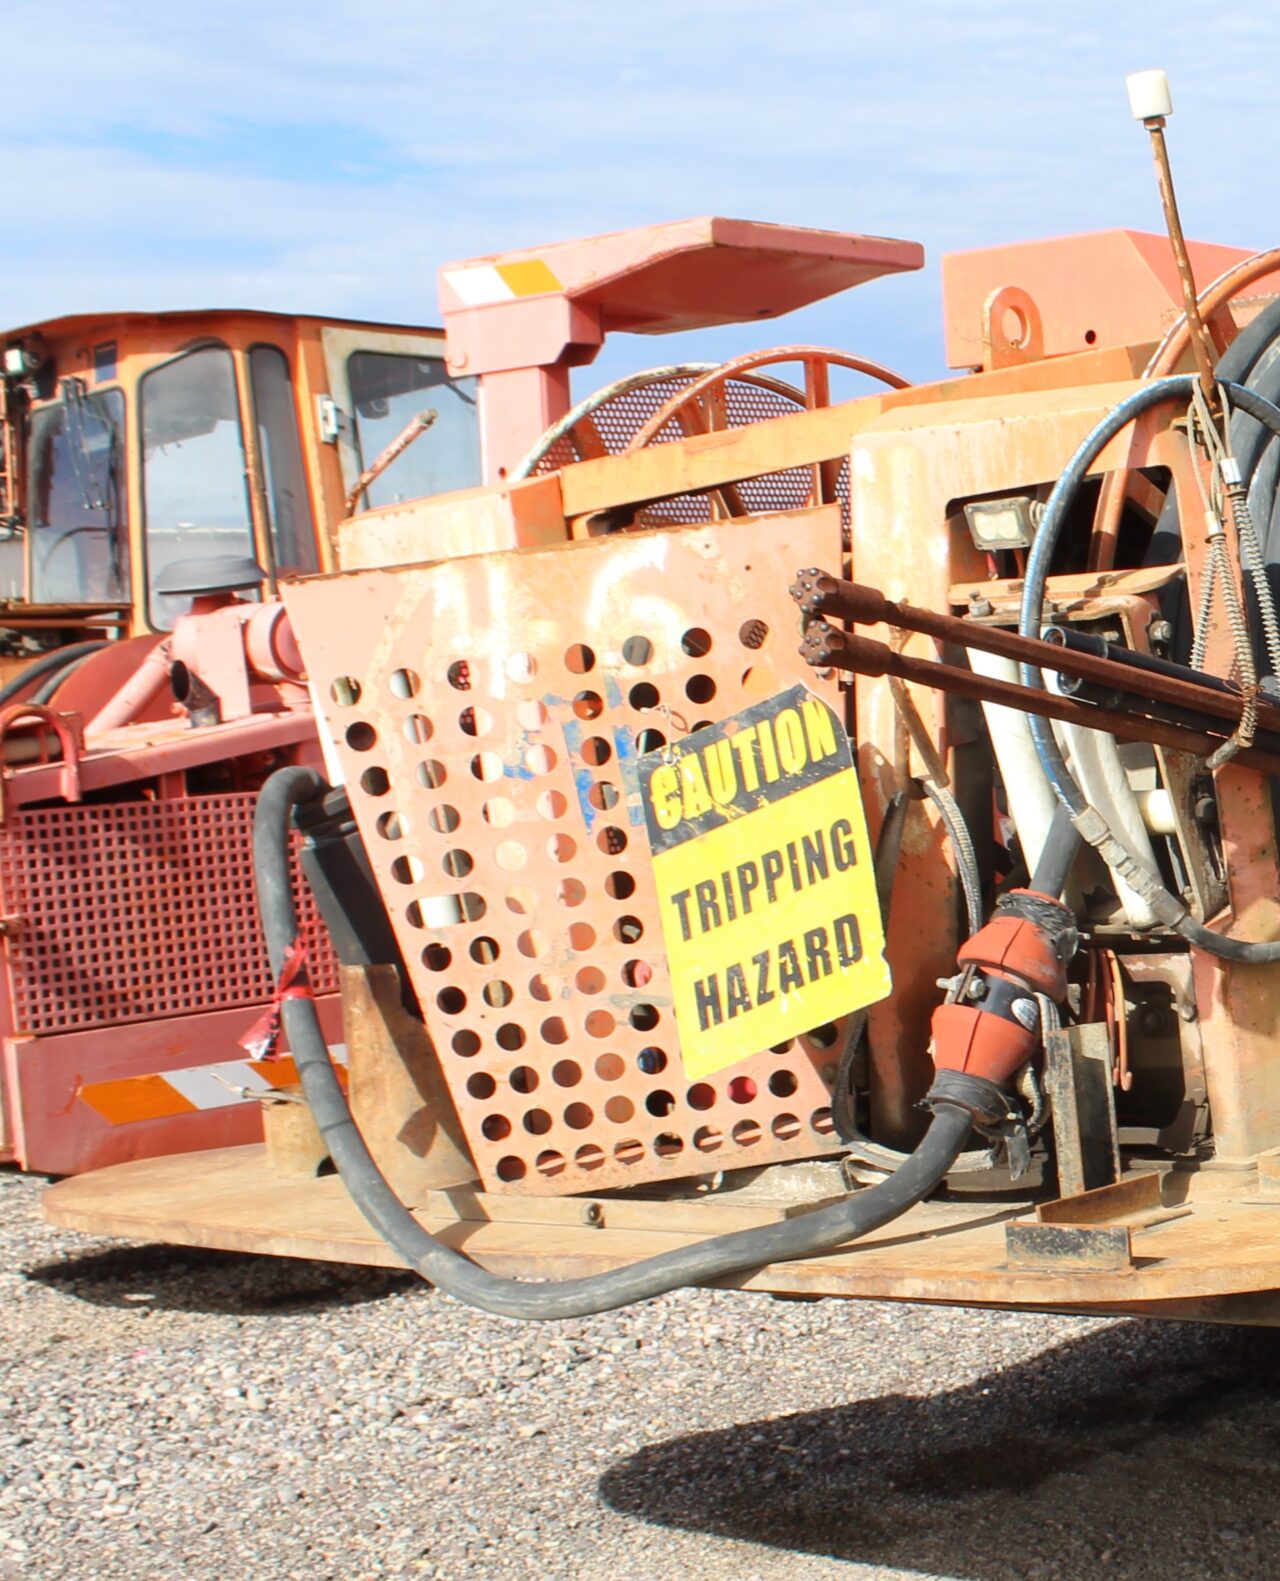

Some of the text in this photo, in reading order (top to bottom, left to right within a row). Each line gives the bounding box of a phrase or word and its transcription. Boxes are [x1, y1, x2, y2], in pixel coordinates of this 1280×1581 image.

[650, 698, 838, 831] CAUTION
[670, 818, 858, 942] TRIPPING
[693, 912, 864, 1032] HAZARD
